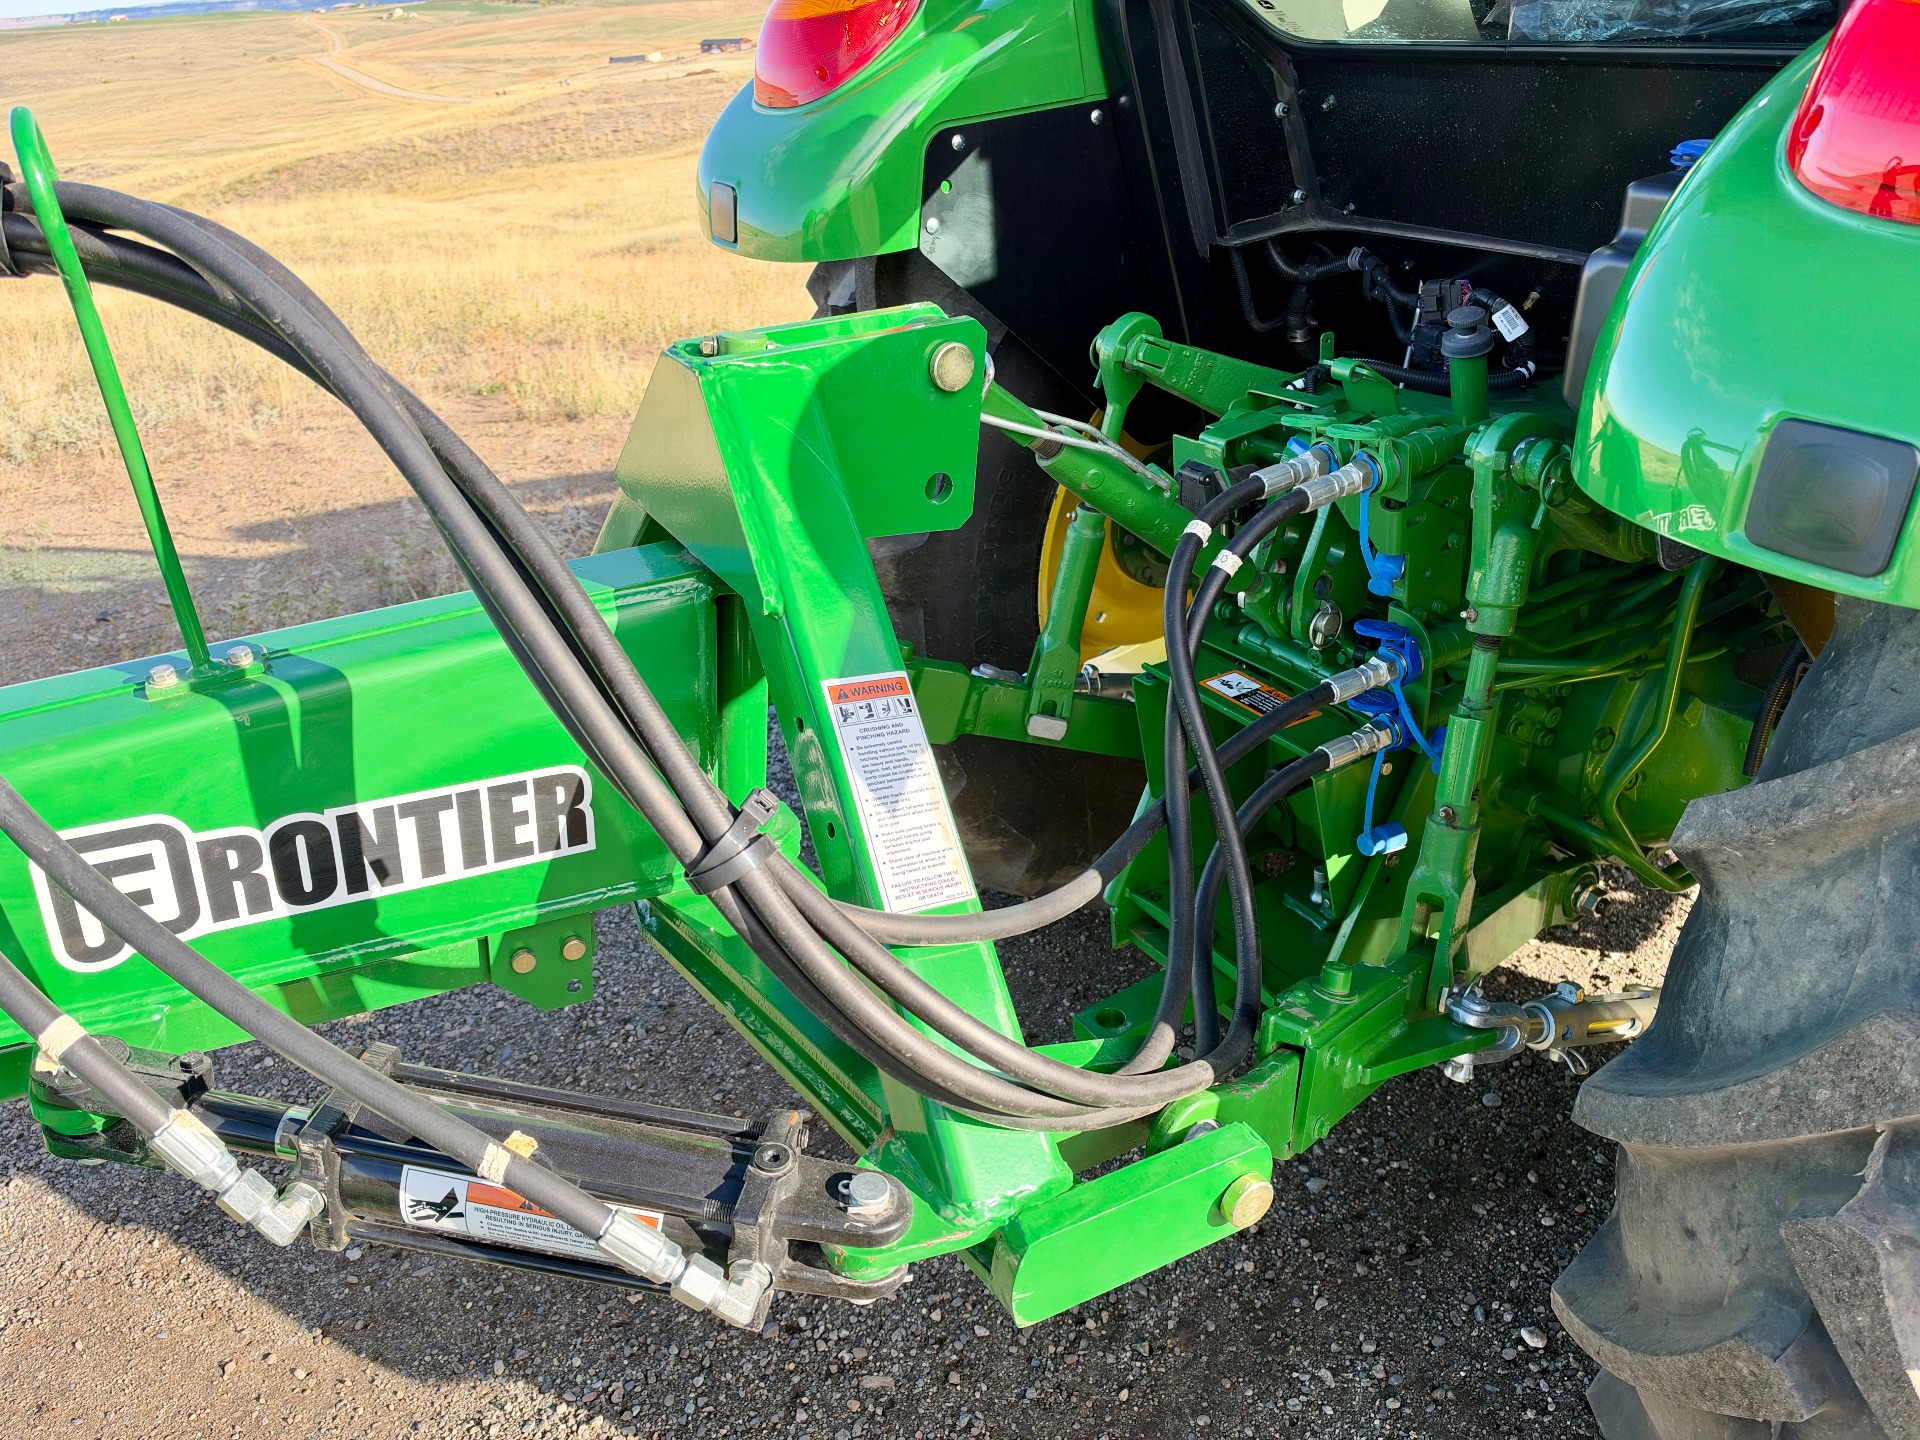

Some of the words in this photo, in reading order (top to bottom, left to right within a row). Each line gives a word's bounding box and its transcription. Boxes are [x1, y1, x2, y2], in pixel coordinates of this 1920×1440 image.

[850, 682, 903, 696] WARNING
[1178, 697, 1191, 724] GATES
[856, 732, 886, 741] PINCHING
[887, 728, 911, 736] HAZARD
[859, 724, 891, 733] CRUSHING
[864, 742, 886, 750] extremely
[871, 794, 890, 802] Operate
[44, 771, 590, 964] FRONTIER
[896, 860, 919, 869] operation
[892, 880, 913, 888] FAILURE
[922, 873, 943, 881] FOLLOW
[944, 869, 959, 877] THESE
[900, 880, 938, 893] INSTRUCTIONS
[938, 876, 956, 884] COULD
[895, 891, 915, 900] RESULT
[923, 885, 944, 893] SERIOUS
[945, 880, 962, 888] INJURY
[927, 890, 944, 898] DEATH
[474, 1207, 521, 1221] HIGH-PRESSURE
[522, 1216, 555, 1227] HYDRAULIC
[486, 1215, 517, 1225] RESULTING
[526, 1223, 551, 1232] SERIOUS
[552, 1228, 574, 1238] INJURY,
